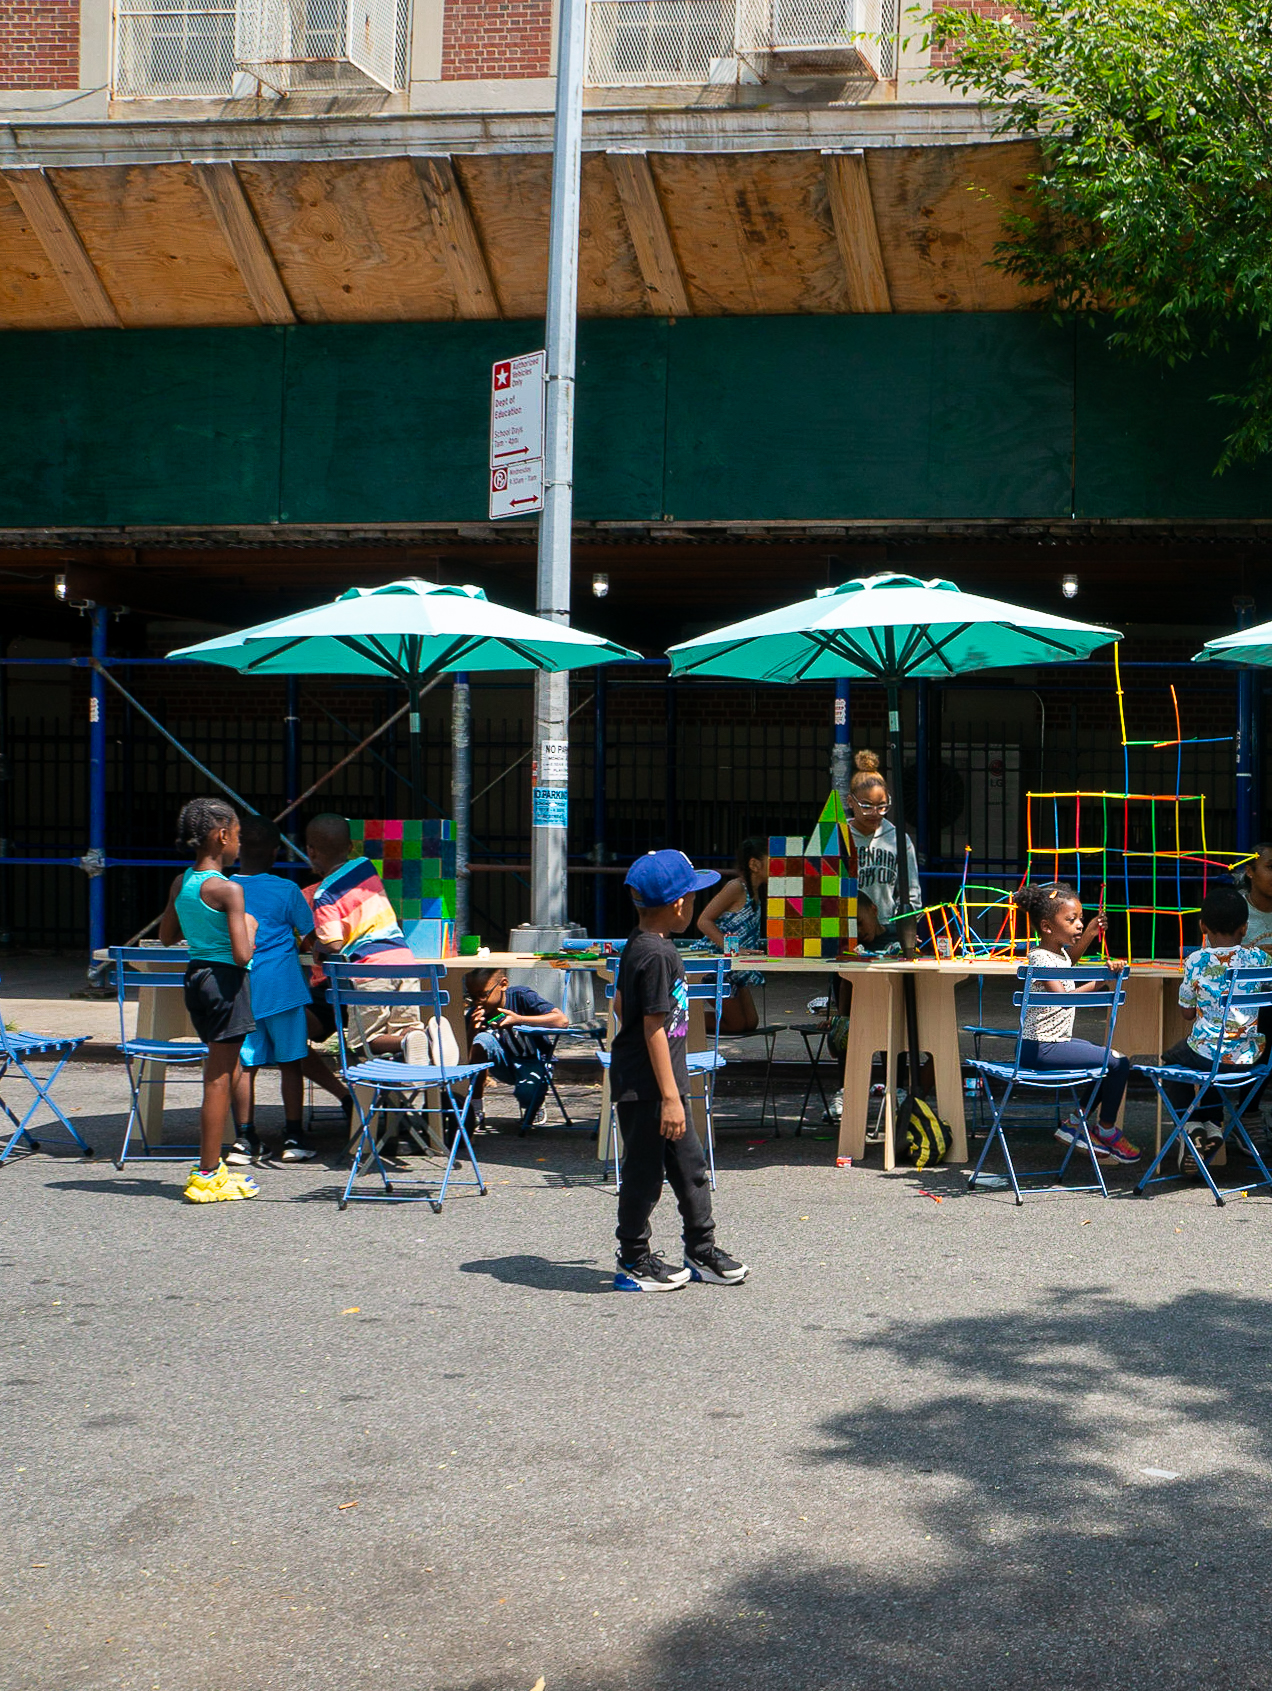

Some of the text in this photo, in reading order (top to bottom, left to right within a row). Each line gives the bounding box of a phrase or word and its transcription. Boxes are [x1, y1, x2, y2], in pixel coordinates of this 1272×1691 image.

[513, 357, 539, 370] Authorized
[512, 379, 523, 388] Only
[495, 398, 508, 408] Dept
[495, 407, 522, 420] Education
[494, 426, 524, 439] School Days
[545, 744, 556, 754] NO
